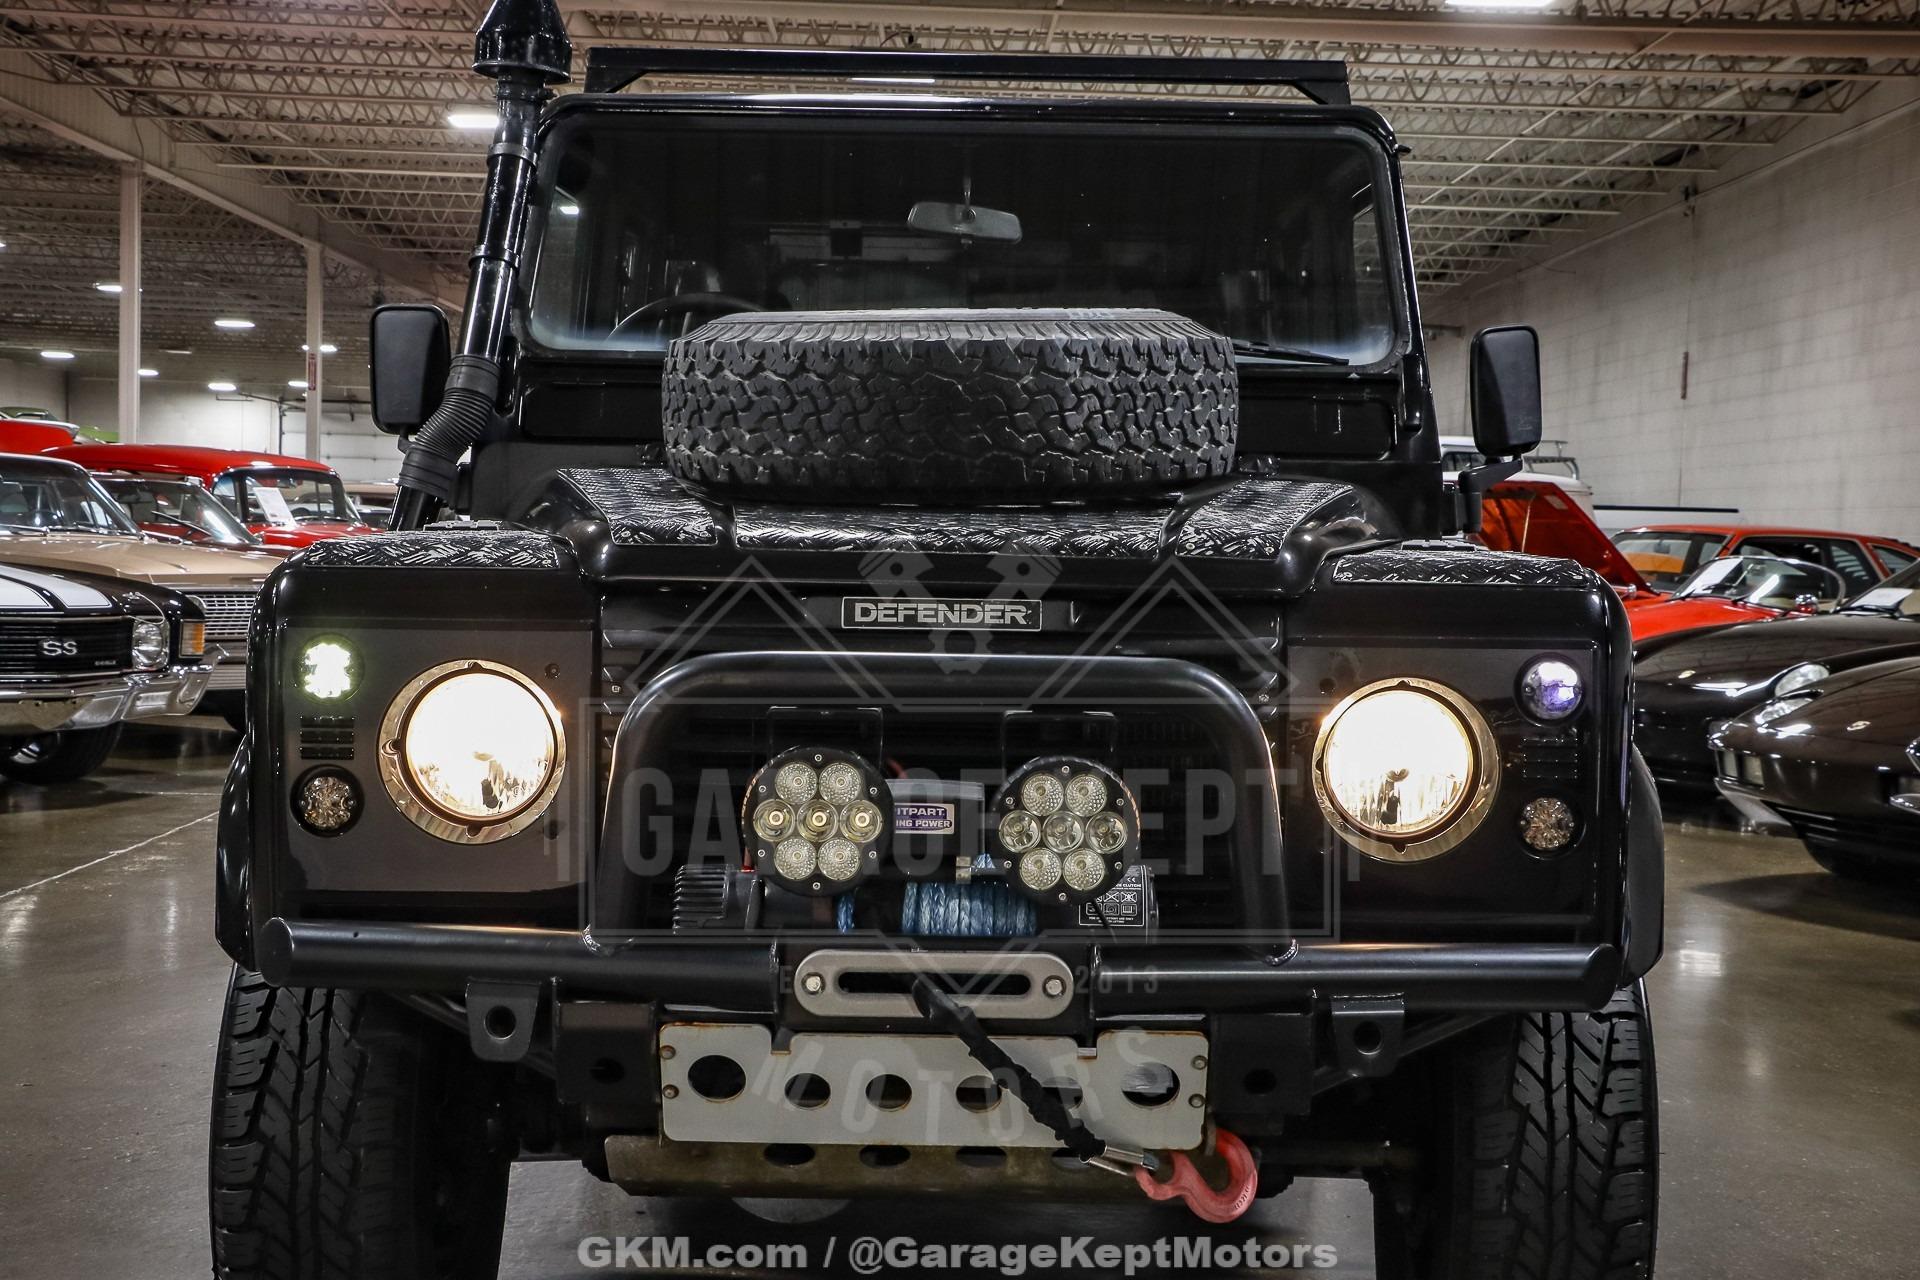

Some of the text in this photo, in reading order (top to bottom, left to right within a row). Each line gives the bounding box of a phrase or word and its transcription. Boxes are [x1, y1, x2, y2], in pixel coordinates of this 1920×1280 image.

[855, 602, 1028, 625] DEFENDER
[42, 640, 78, 656] SS
[895, 807, 945, 816] ITPART
[915, 820, 951, 828] POWER
